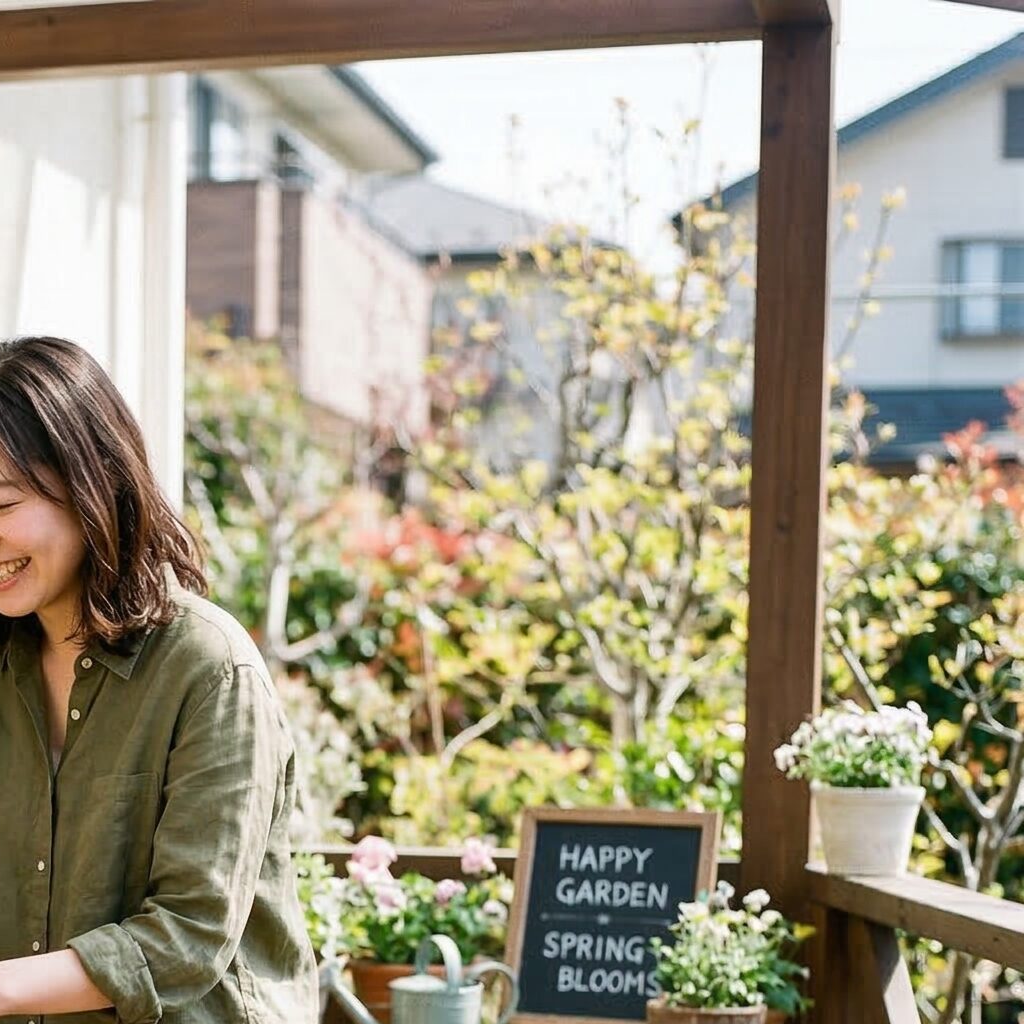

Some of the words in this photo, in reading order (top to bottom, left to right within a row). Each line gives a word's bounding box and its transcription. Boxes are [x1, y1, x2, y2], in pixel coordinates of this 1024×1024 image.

[559, 843, 653, 874] HAPPY
[556, 877, 669, 910] GARDEN
[542, 931, 646, 964] SPRING
[557, 965, 663, 997] BLOOMS
